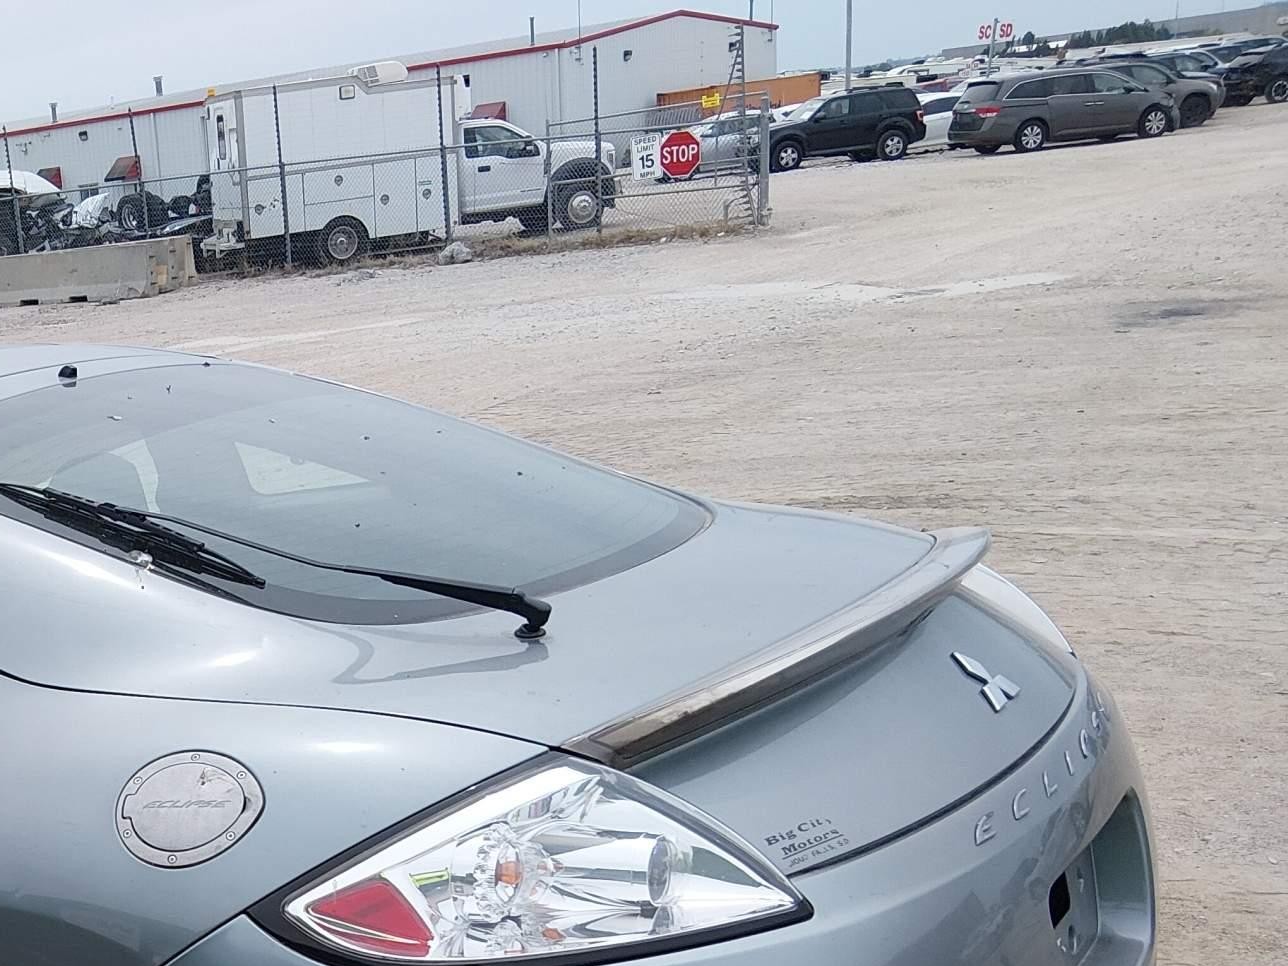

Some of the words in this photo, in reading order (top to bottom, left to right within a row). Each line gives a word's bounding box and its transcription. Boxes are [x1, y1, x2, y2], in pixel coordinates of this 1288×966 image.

[978, 25, 992, 40] SC
[999, 23, 1013, 38] SD
[634, 135, 657, 145] SPEED
[636, 145, 655, 153] LIMIT
[662, 144, 698, 164] STOP
[638, 153, 655, 169] 15
[639, 170, 656, 178] MPH
[142, 799, 231, 809] ECLIPSE
[764, 829, 797, 846] Big
[781, 828, 840, 856] Motors
